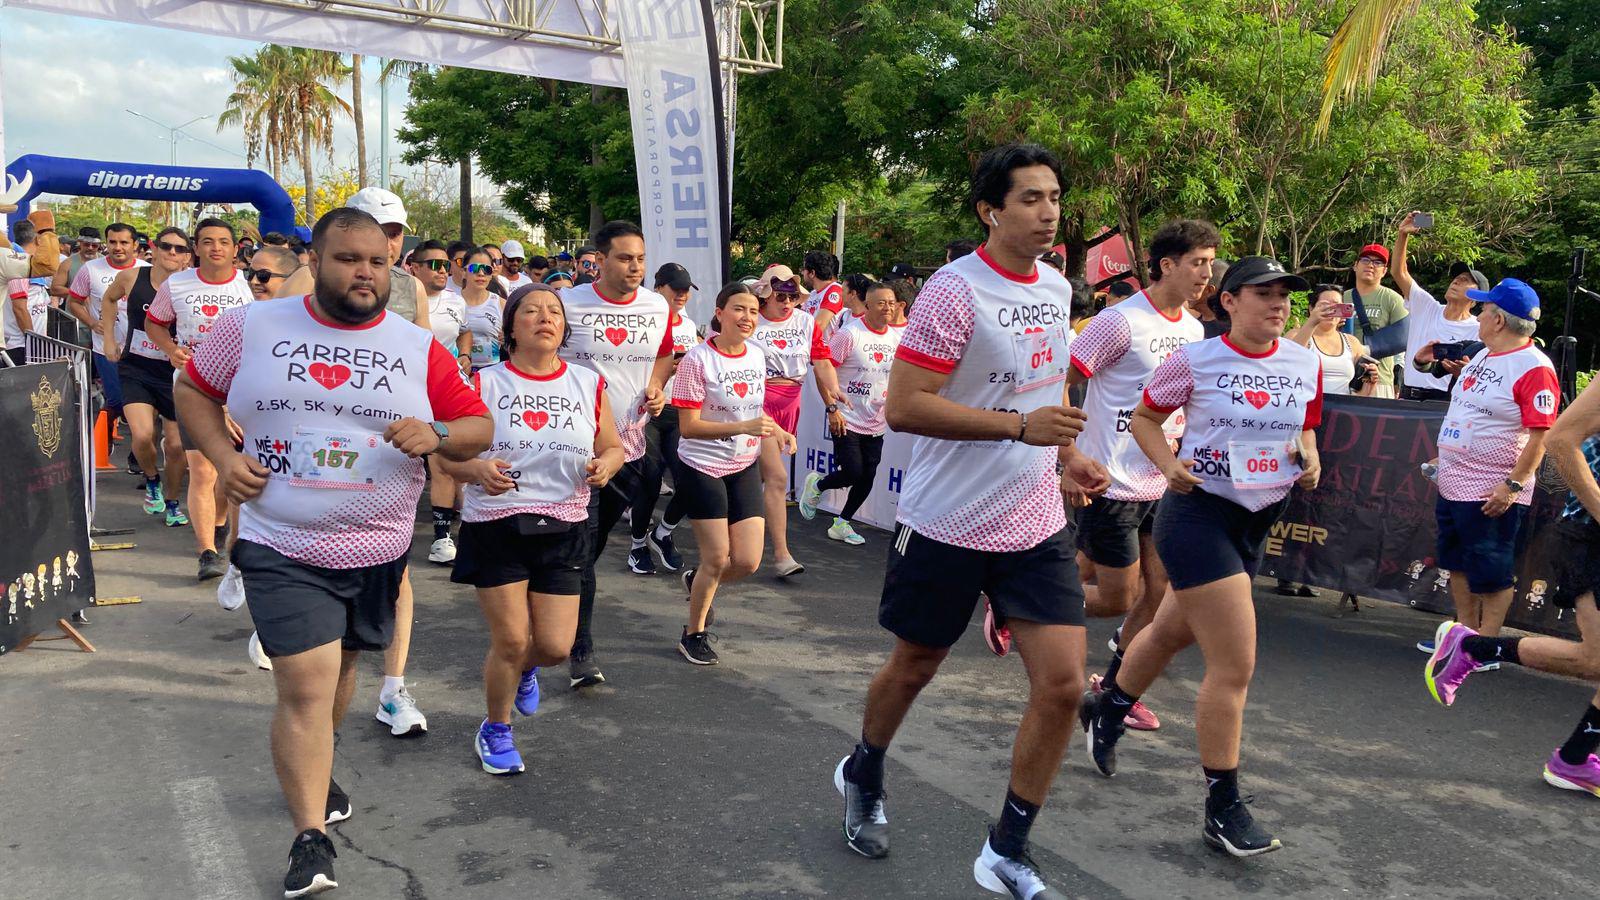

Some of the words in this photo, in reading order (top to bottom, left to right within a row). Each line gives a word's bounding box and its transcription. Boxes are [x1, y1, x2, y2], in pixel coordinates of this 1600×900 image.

[88, 170, 203, 191] dportenis
[185, 294, 243, 305] CARRERA
[581, 313, 657, 328] CARRERA
[998, 303, 1068, 328] CARRERA
[757, 328, 806, 341] CARRERA
[272, 340, 407, 376] CARRERA
[603, 354, 615, 362] 5K
[1031, 347, 1053, 369] 074
[718, 369, 764, 383] CARRERA
[1217, 373, 1303, 390] CARRERA
[847, 387, 870, 396] DONA
[256, 399, 297, 412] 2.5K,
[304, 400, 326, 412] 5K
[333, 404, 344, 416] y
[352, 404, 403, 420] Camin
[498, 394, 583, 415] CARRERA
[1210, 418, 1236, 429] 2.5K,
[1241, 418, 1255, 428] 5K
[1260, 422, 1267, 430] y
[520, 440, 533, 449] 5K
[538, 443, 545, 451] y
[258, 453, 292, 475] DON
[312, 448, 359, 469] 157
[1247, 458, 1279, 473] 069
[1193, 459, 1232, 478] DON
[1270, 520, 1329, 546] WER
